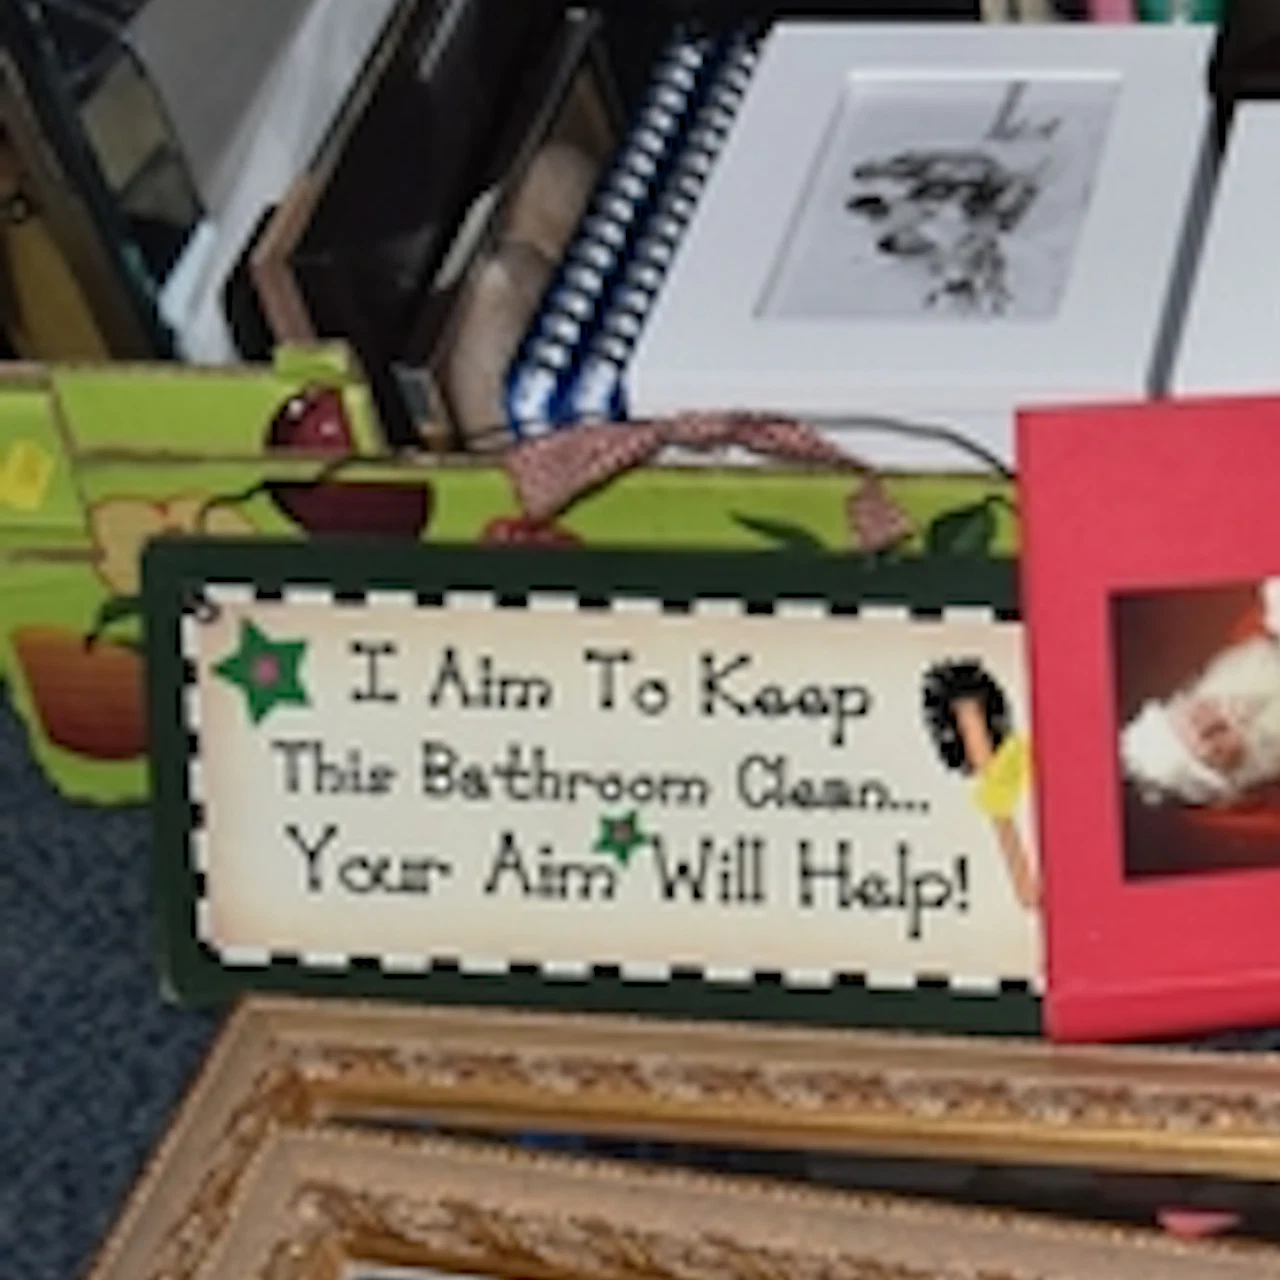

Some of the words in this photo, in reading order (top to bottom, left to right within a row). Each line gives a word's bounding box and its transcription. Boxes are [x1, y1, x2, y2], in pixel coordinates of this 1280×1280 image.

[347, 639, 399, 703] I
[429, 645, 552, 710] Aim
[583, 648, 670, 716] To
[700, 650, 871, 746] Keep
[271, 739, 396, 794] This
[421, 739, 709, 807] Bathroom
[737, 752, 930, 812] Clean...
[284, 823, 454, 894] Your
[483, 830, 616, 900] Aim
[650, 834, 765, 903] Will
[798, 839, 971, 940] Help!
